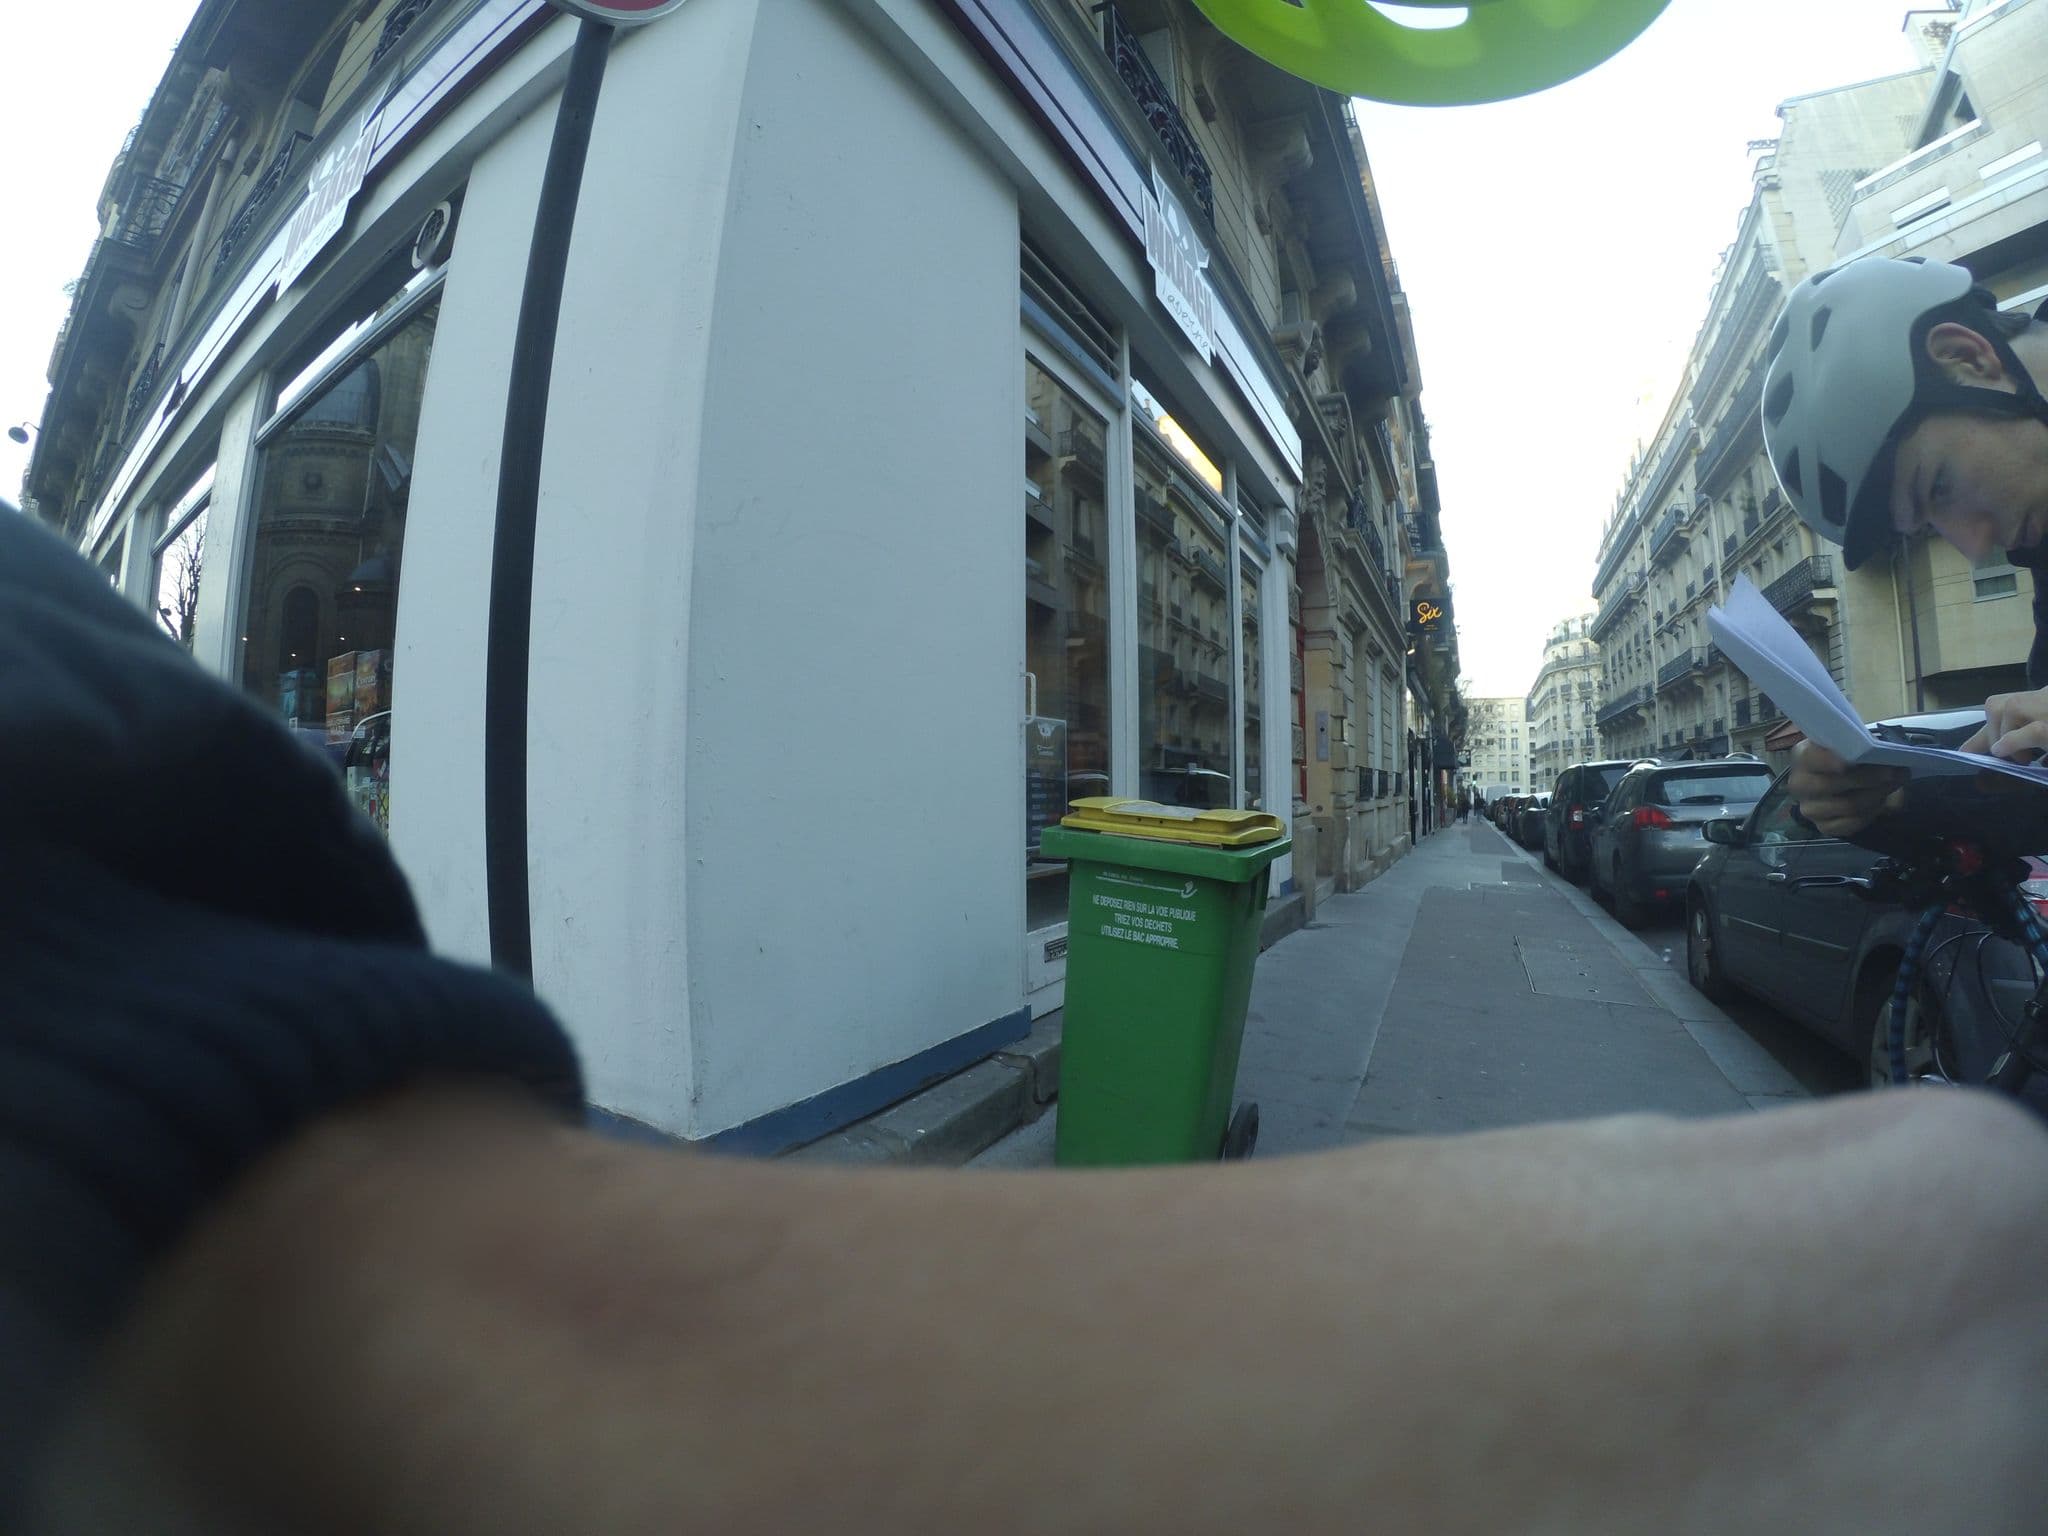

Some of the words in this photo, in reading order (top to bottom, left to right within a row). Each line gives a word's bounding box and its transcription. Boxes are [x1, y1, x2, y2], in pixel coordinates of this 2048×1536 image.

[1417, 602, 1443, 624] Six
[1092, 894, 1100, 905] NE
[1100, 896, 1123, 910] DEPOSEZ
[1124, 900, 1136, 912] RIEN
[1136, 902, 1147, 913] SUR
[1147, 904, 1155, 915] LA
[1156, 905, 1168, 917] VOIE
[1169, 908, 1197, 922] PUBLIQUE
[1114, 913, 1130, 925] TRIEZ
[1131, 916, 1143, 928] VOS
[1144, 919, 1173, 933] DECHETS
[1101, 925, 1124, 939] UTILISEZ
[1124, 930, 1132, 940] LE
[1132, 931, 1145, 943] BAC
